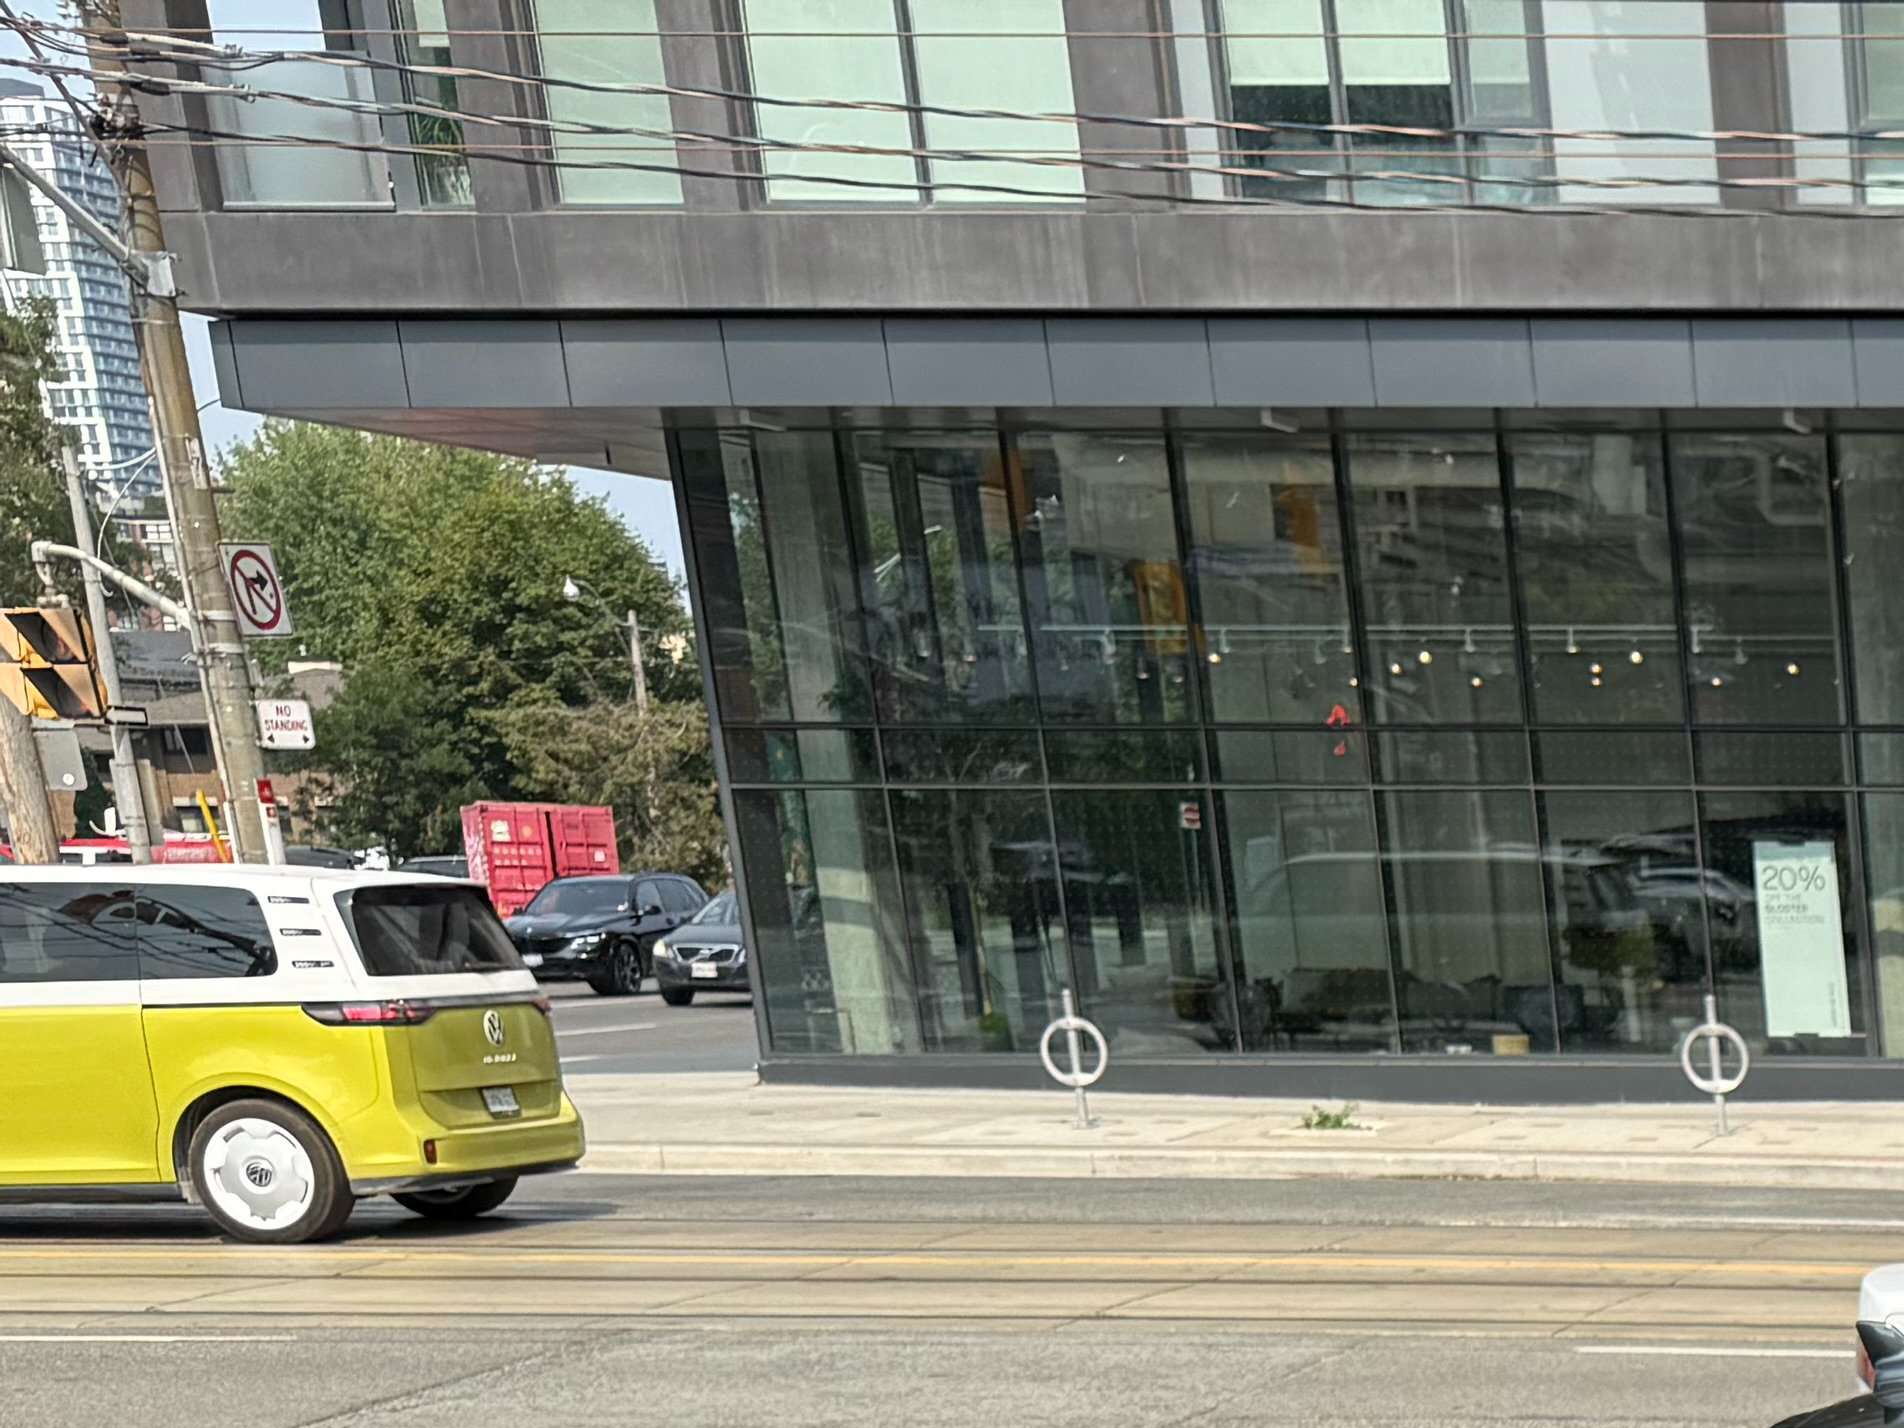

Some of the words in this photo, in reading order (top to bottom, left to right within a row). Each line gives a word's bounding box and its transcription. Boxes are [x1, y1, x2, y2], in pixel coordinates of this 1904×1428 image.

[275, 705, 291, 717] NO
[265, 720, 308, 731] STANDING
[1762, 865, 1826, 891] 20%
